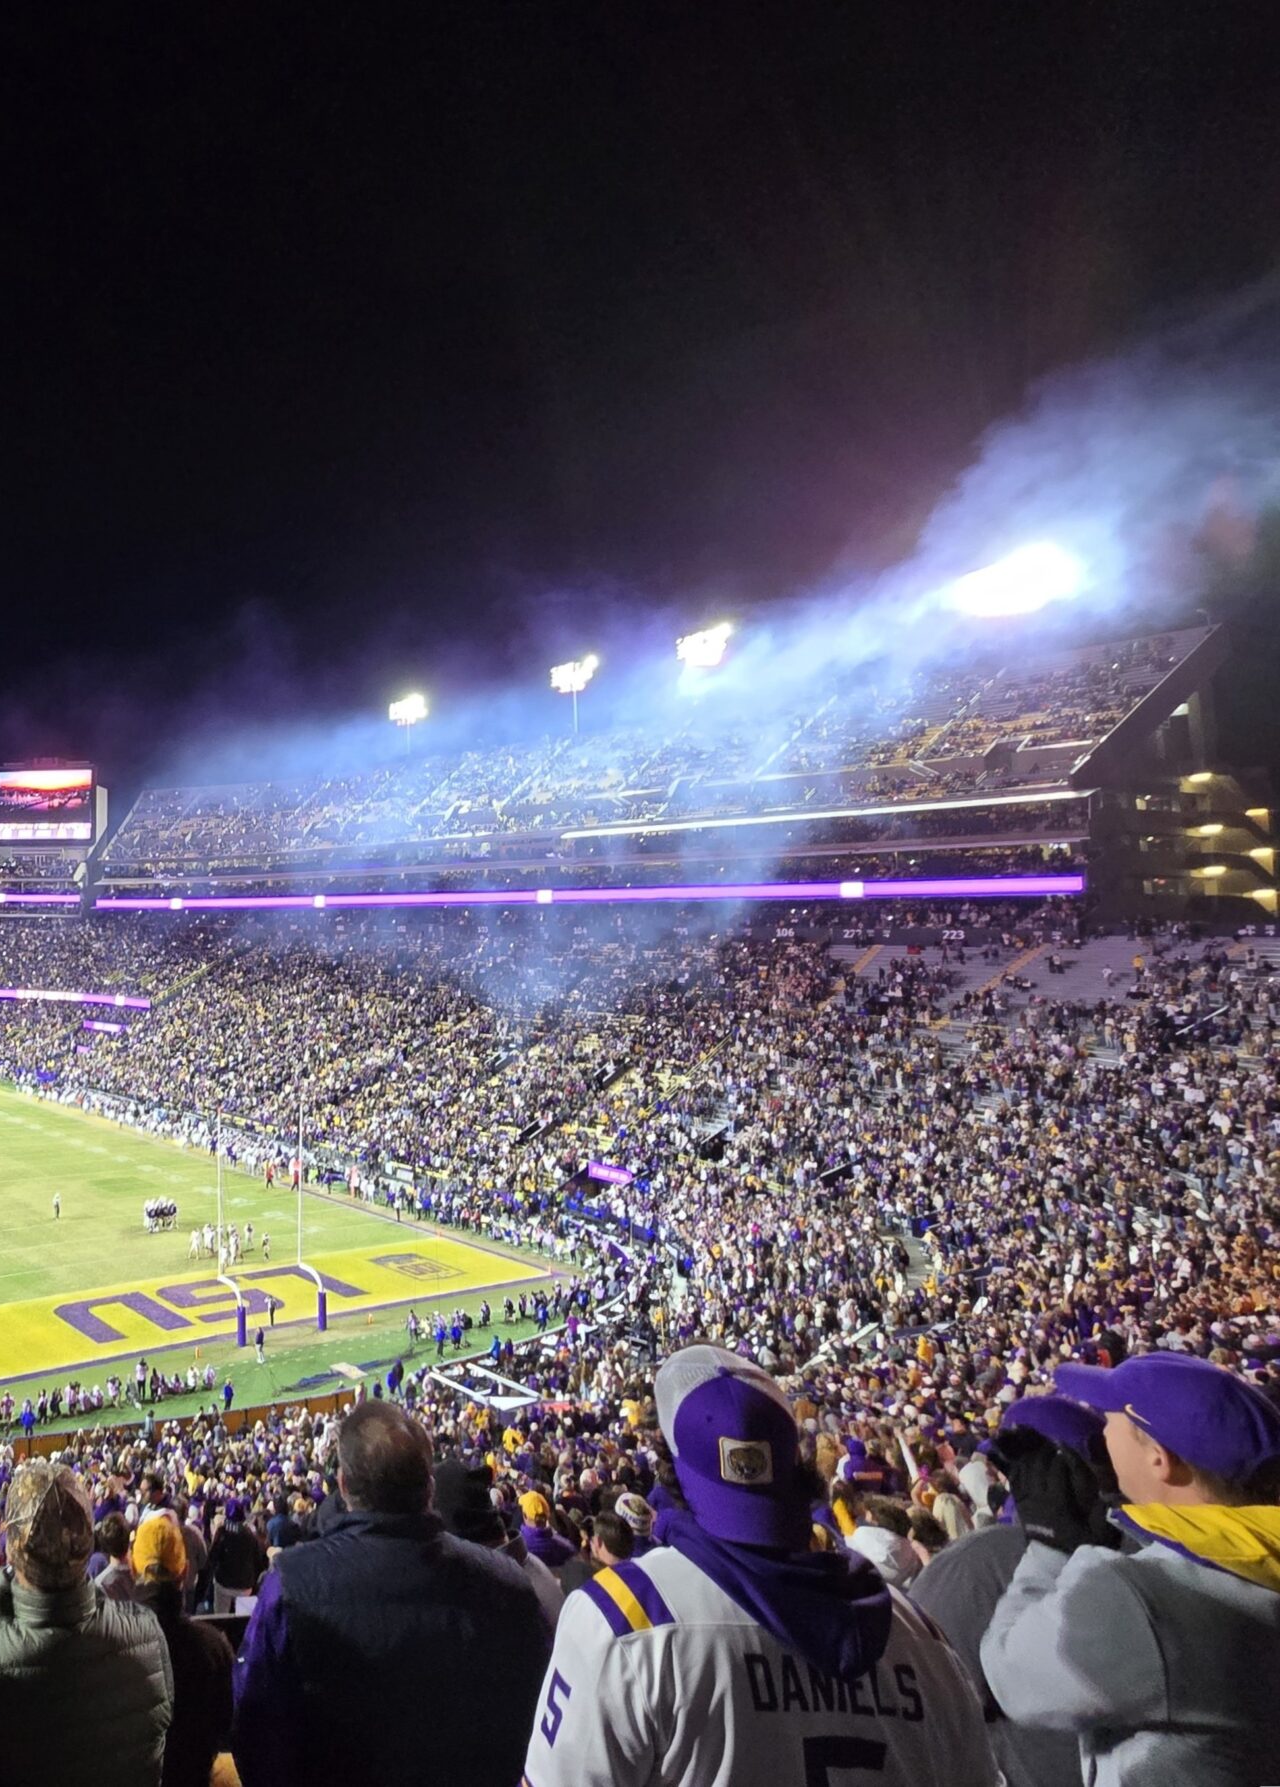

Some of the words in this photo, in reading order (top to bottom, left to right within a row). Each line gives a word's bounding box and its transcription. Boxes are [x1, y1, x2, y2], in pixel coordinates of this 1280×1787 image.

[776, 928, 795, 937] 106
[942, 930, 965, 940] 223
[53, 1264, 371, 1344] LSU
[541, 1666, 572, 1749] 5
[744, 1653, 924, 1722] DANIELS
